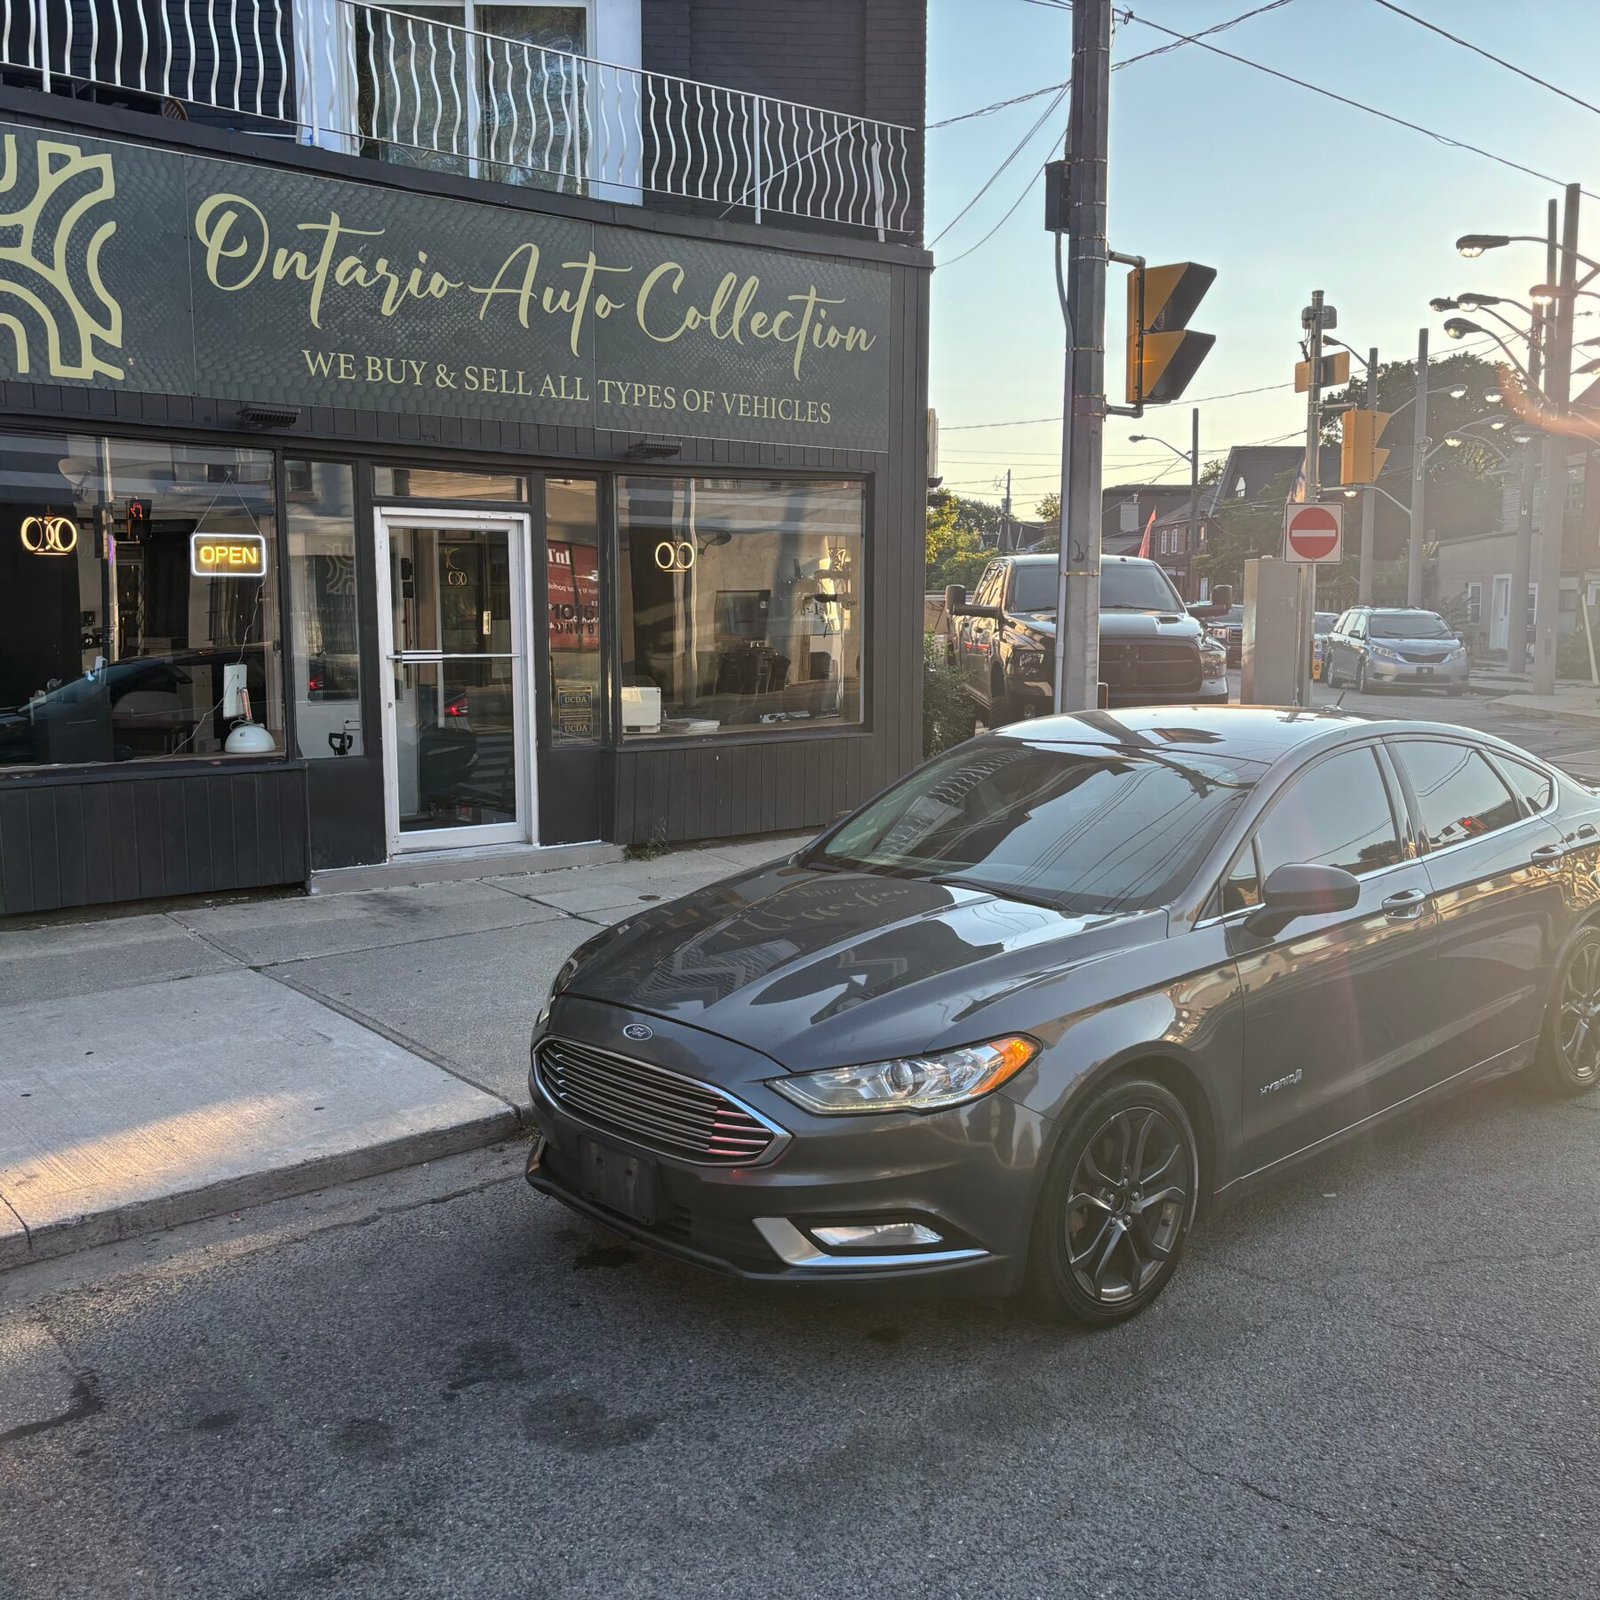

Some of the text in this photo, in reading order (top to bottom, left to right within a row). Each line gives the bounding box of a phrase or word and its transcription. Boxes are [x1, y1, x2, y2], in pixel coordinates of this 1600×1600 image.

[195, 193, 876, 382] Ontario Auto Collection
[302, 350, 831, 425] WE BUY & SELL ALL TYPES OF VEHICLES
[199, 545, 257, 564] OPEN
[588, 623, 595, 634] B
[564, 696, 588, 704] UCDA
[564, 724, 589, 732] UCDA
